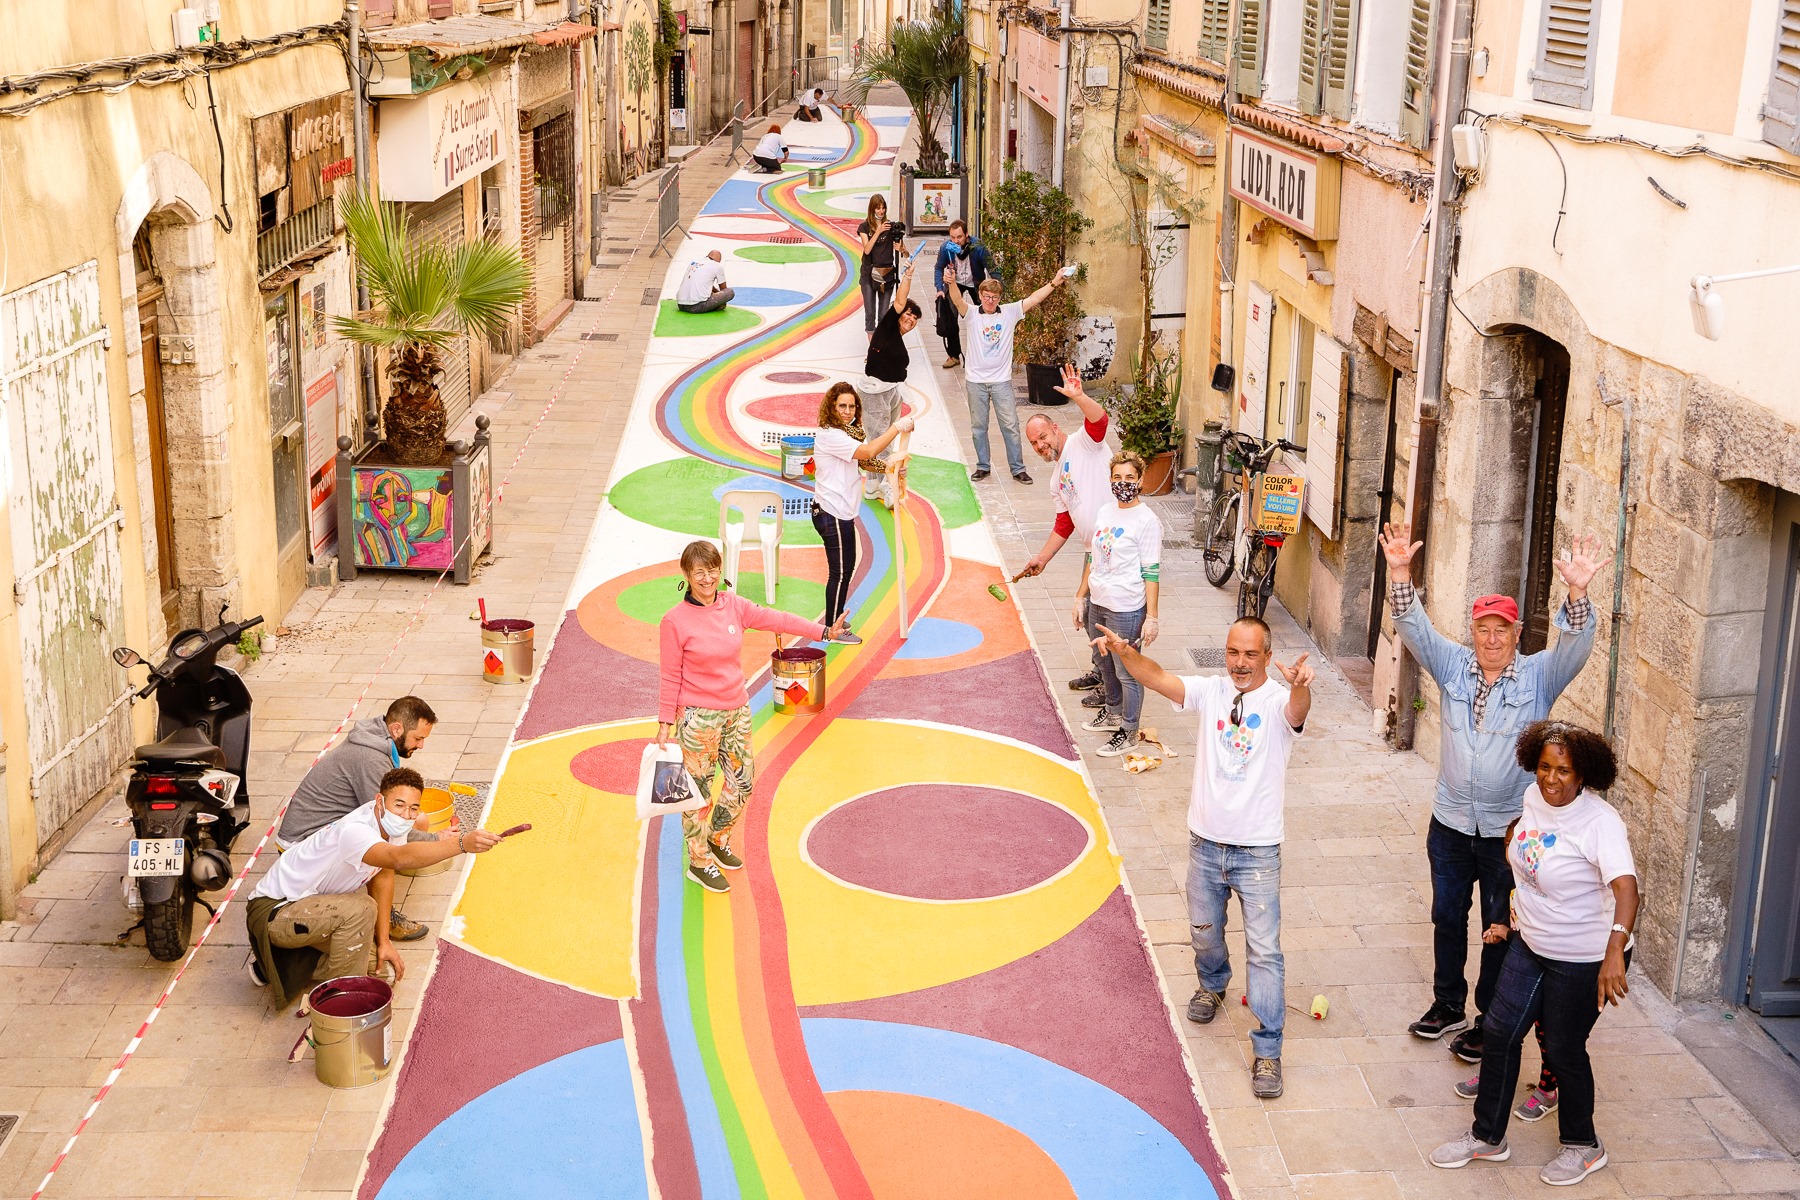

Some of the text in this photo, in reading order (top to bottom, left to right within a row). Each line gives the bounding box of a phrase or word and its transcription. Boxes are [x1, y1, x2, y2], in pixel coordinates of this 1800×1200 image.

[450, 103, 459, 133] Le
[460, 89, 490, 130] Comptoir
[455, 127, 489, 173] Sucré Salé
[1241, 143, 1306, 221] LUDO.ADO
[317, 468, 334, 497] POINT
[1264, 483, 1284, 491] CUIR
[1265, 476, 1293, 485] COLOR
[1267, 502, 1296, 513] VOITURE
[1269, 495, 1297, 506] SELLERIE
